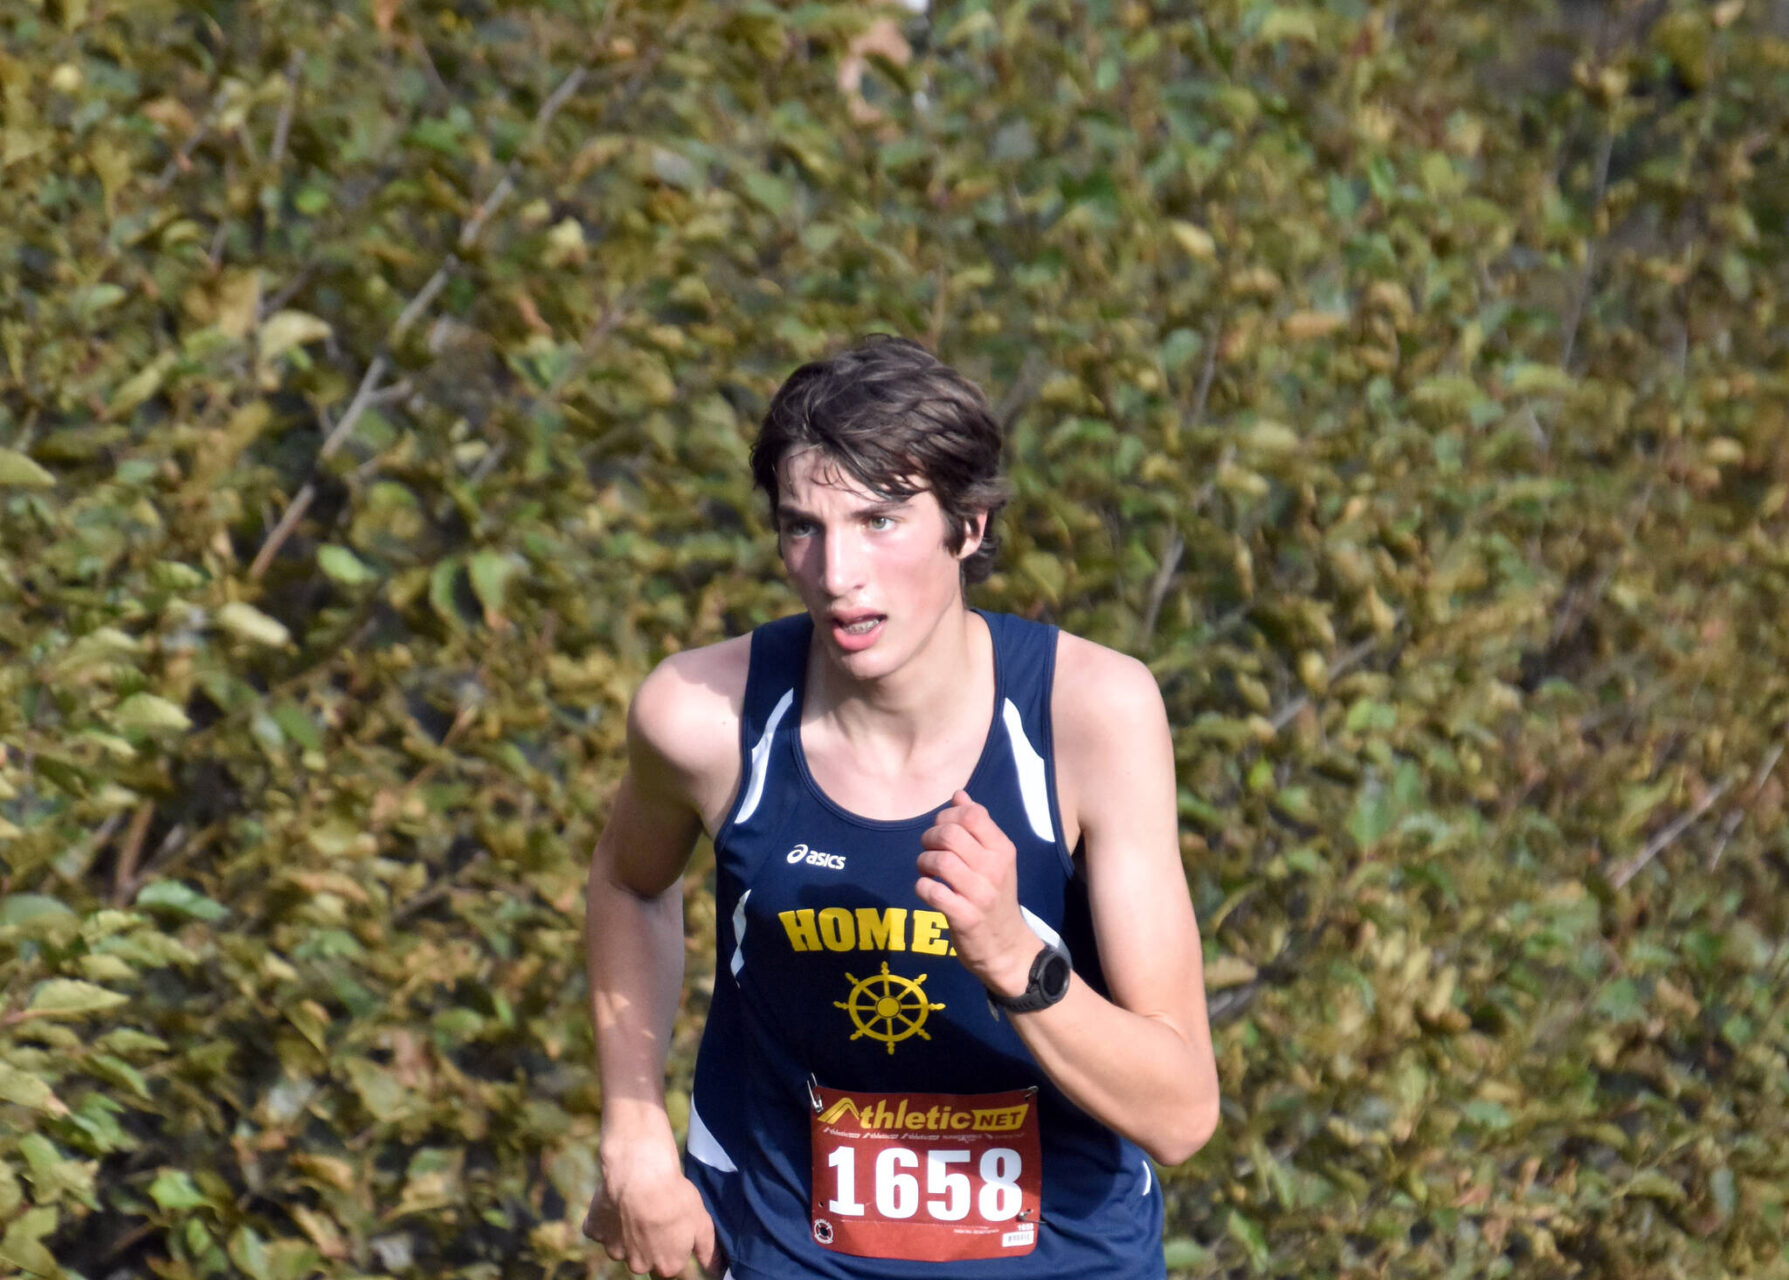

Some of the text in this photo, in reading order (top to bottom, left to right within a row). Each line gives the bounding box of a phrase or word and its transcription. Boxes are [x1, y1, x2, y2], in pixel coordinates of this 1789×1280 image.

[805, 849, 847, 870] asics
[778, 908, 957, 956] HOME
[828, 1145, 1023, 1222] 1658
